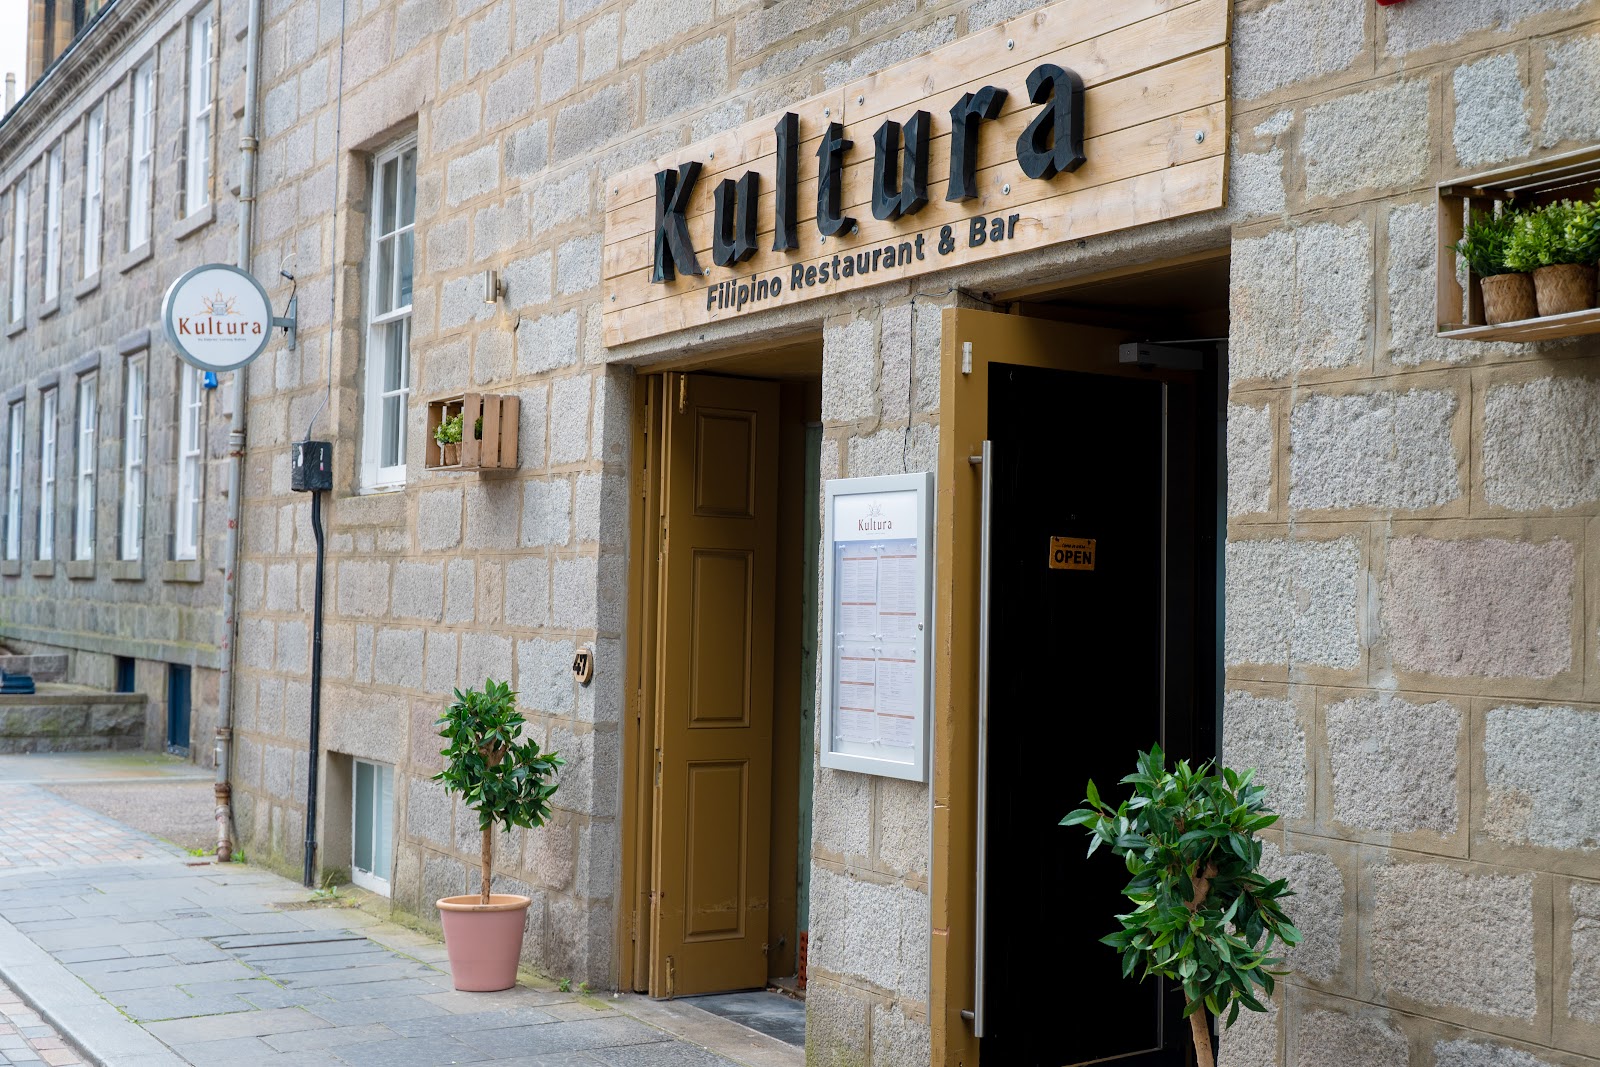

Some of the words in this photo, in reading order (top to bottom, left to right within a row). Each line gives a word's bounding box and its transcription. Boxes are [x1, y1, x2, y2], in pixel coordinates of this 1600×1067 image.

[652, 63, 1087, 285] Kultura
[706, 269, 783, 311] Filipino
[789, 233, 925, 291] Restaurant
[937, 224, 956, 256] &
[968, 213, 1020, 248] Bar
[178, 316, 262, 335] Kultura
[858, 517, 892, 531] Kultura
[1054, 549, 1092, 564] OPEN
[572, 653, 588, 676] 47
